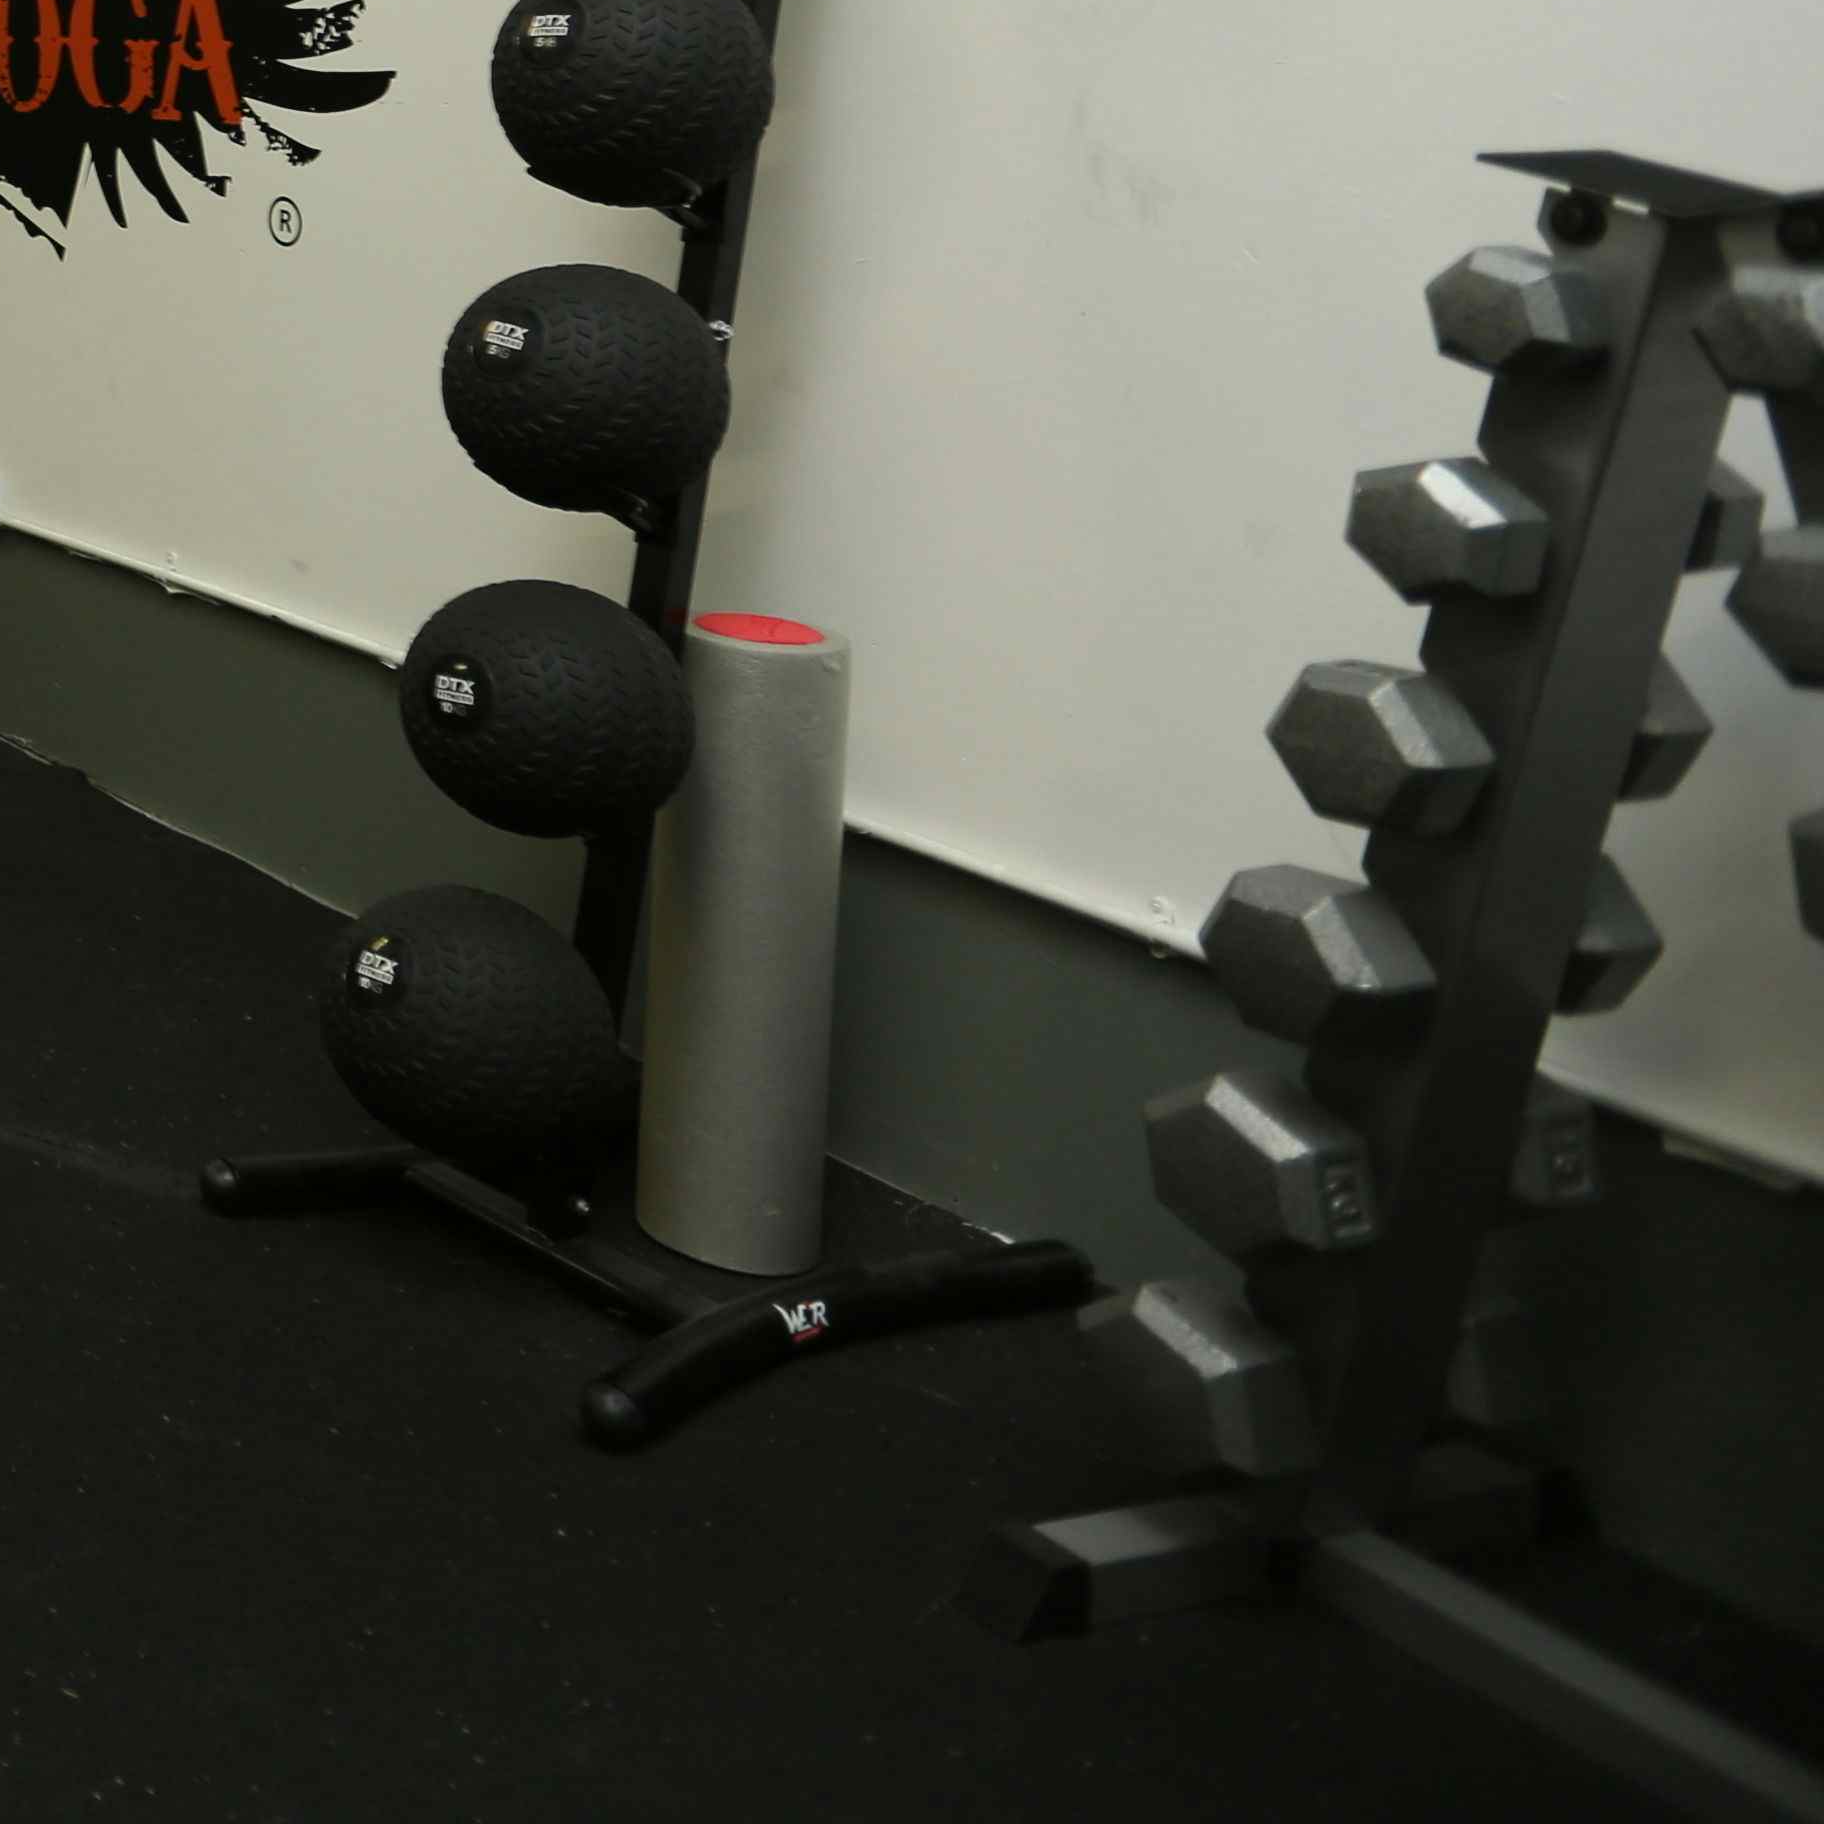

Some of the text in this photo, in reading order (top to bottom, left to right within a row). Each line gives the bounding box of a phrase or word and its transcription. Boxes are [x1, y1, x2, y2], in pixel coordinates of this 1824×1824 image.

[531, 14, 572, 27] DTX
[487, 321, 529, 341] DTX
[435, 675, 475, 695] DTX
[360, 950, 399, 975] DTX
